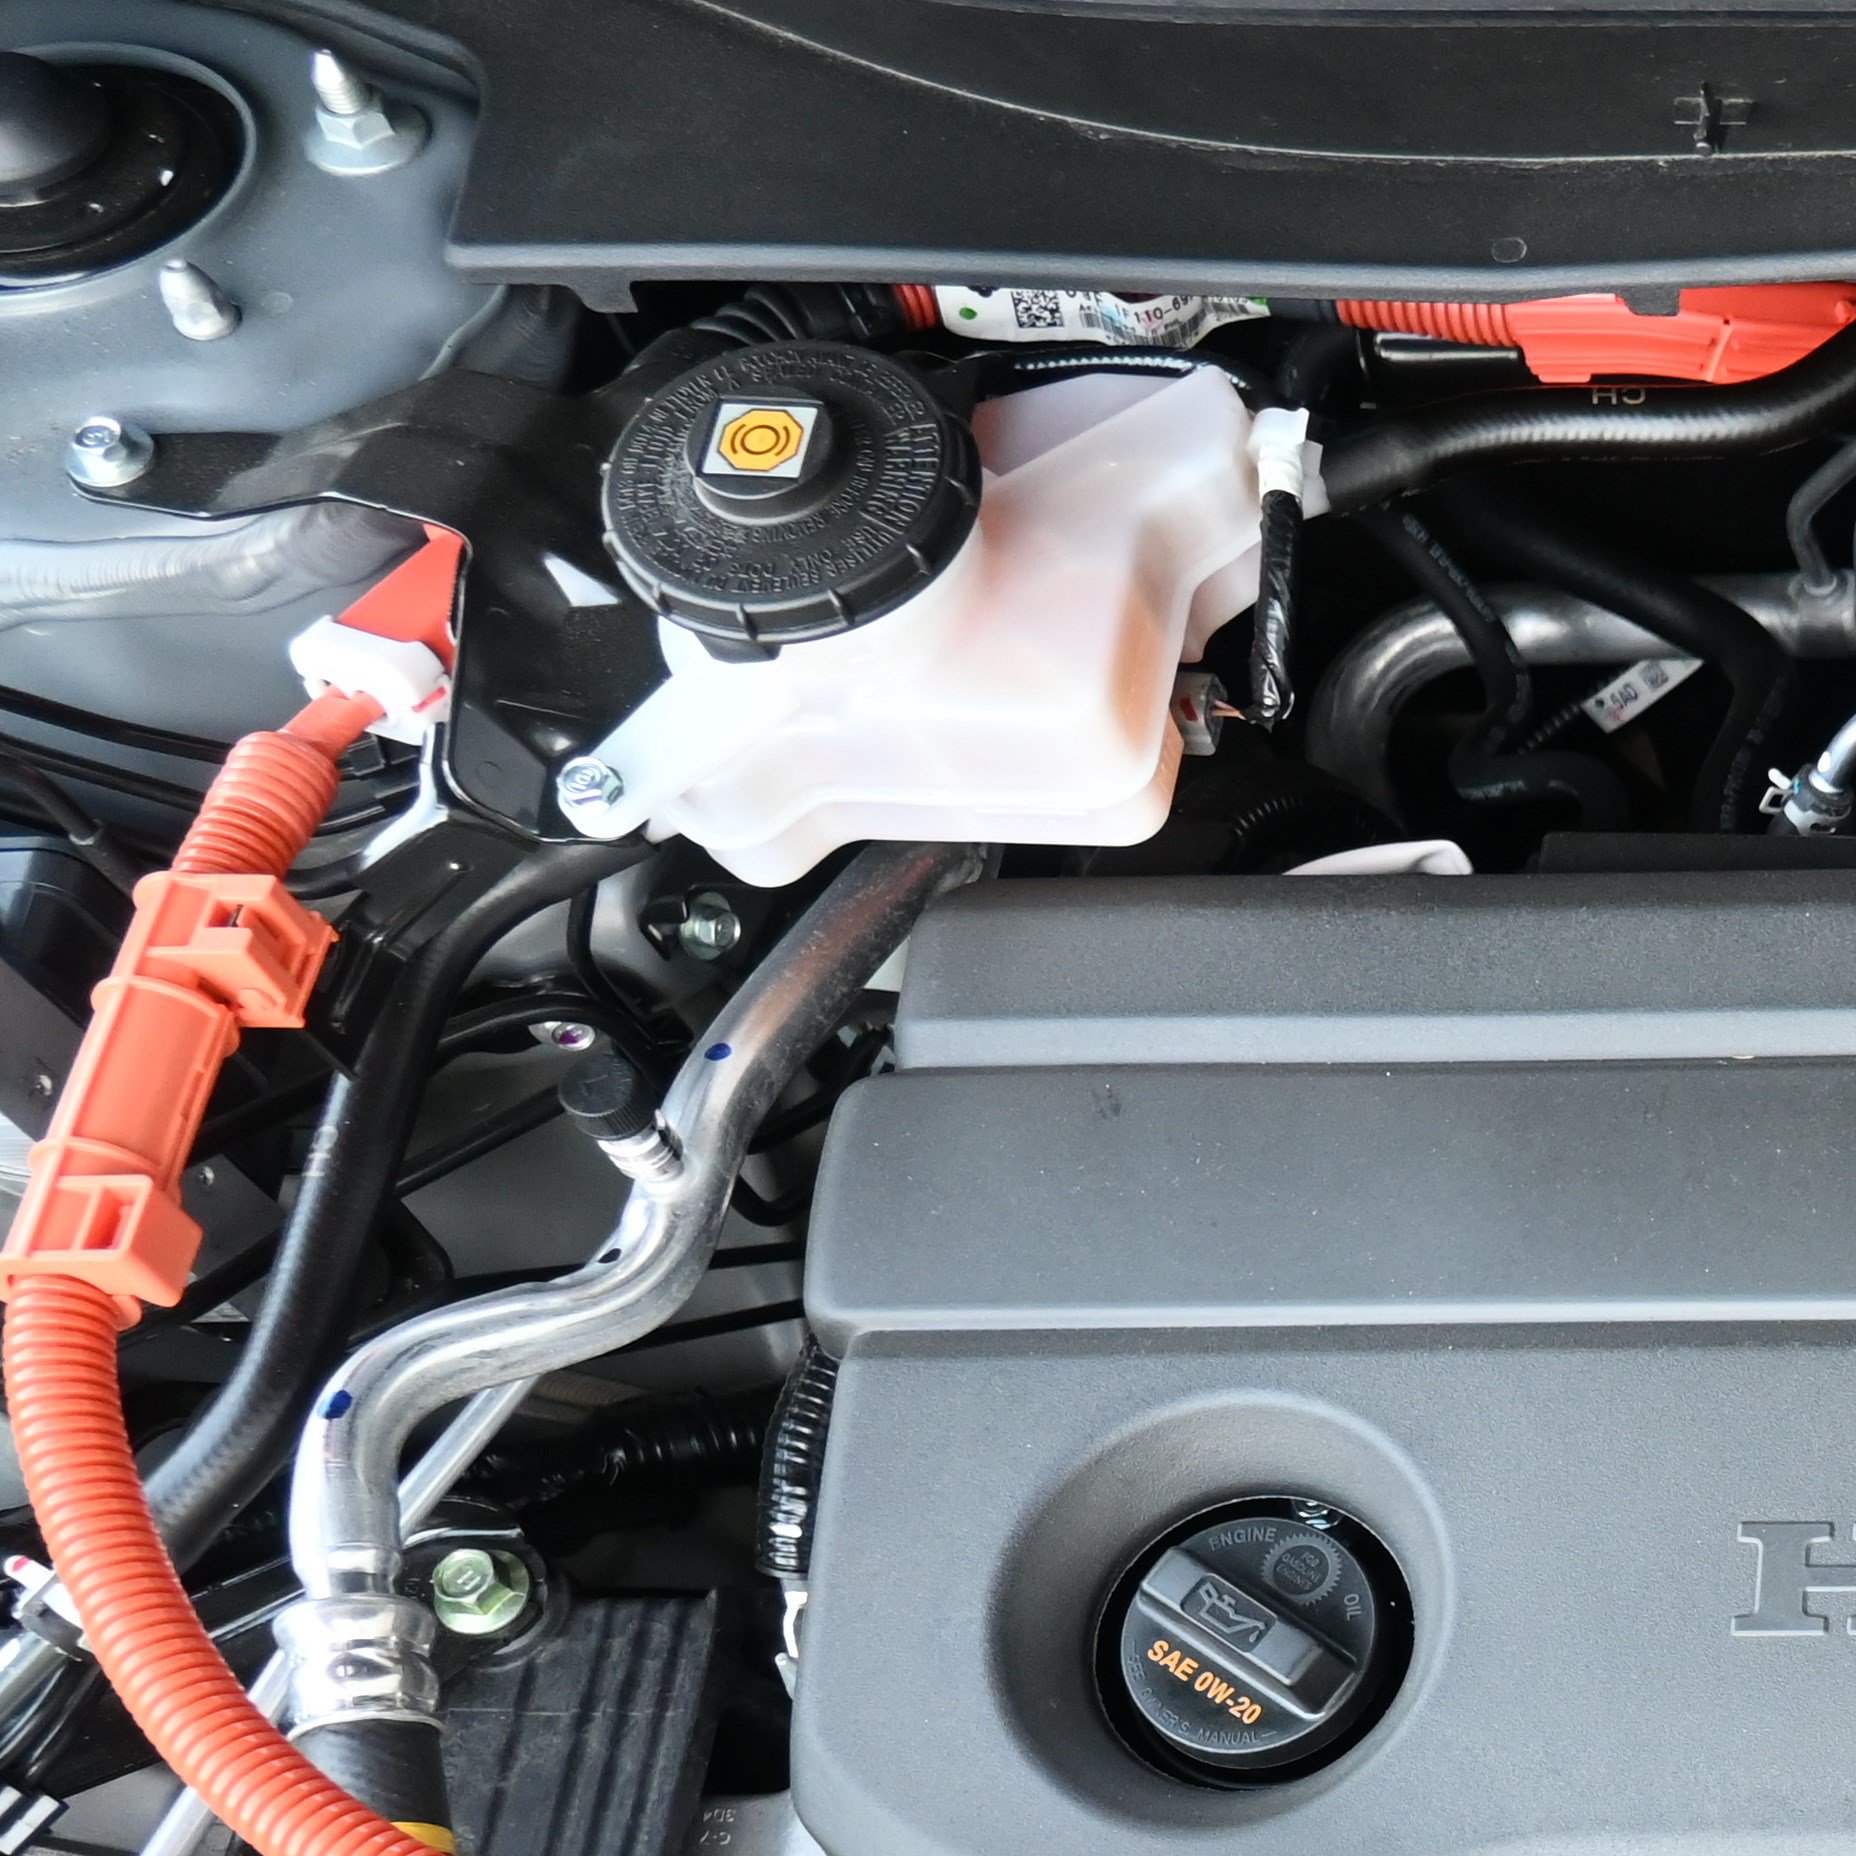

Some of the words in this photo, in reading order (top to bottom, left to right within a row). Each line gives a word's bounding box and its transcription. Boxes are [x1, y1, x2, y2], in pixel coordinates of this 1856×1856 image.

[1208, 1527, 1277, 1551] ENGINE
[1343, 1592, 1362, 1621] OIL
[1147, 1640, 1198, 1682] SAE
[1194, 1671, 1263, 1724] 0W-20
[1198, 1727, 1260, 1744] MANUAL
